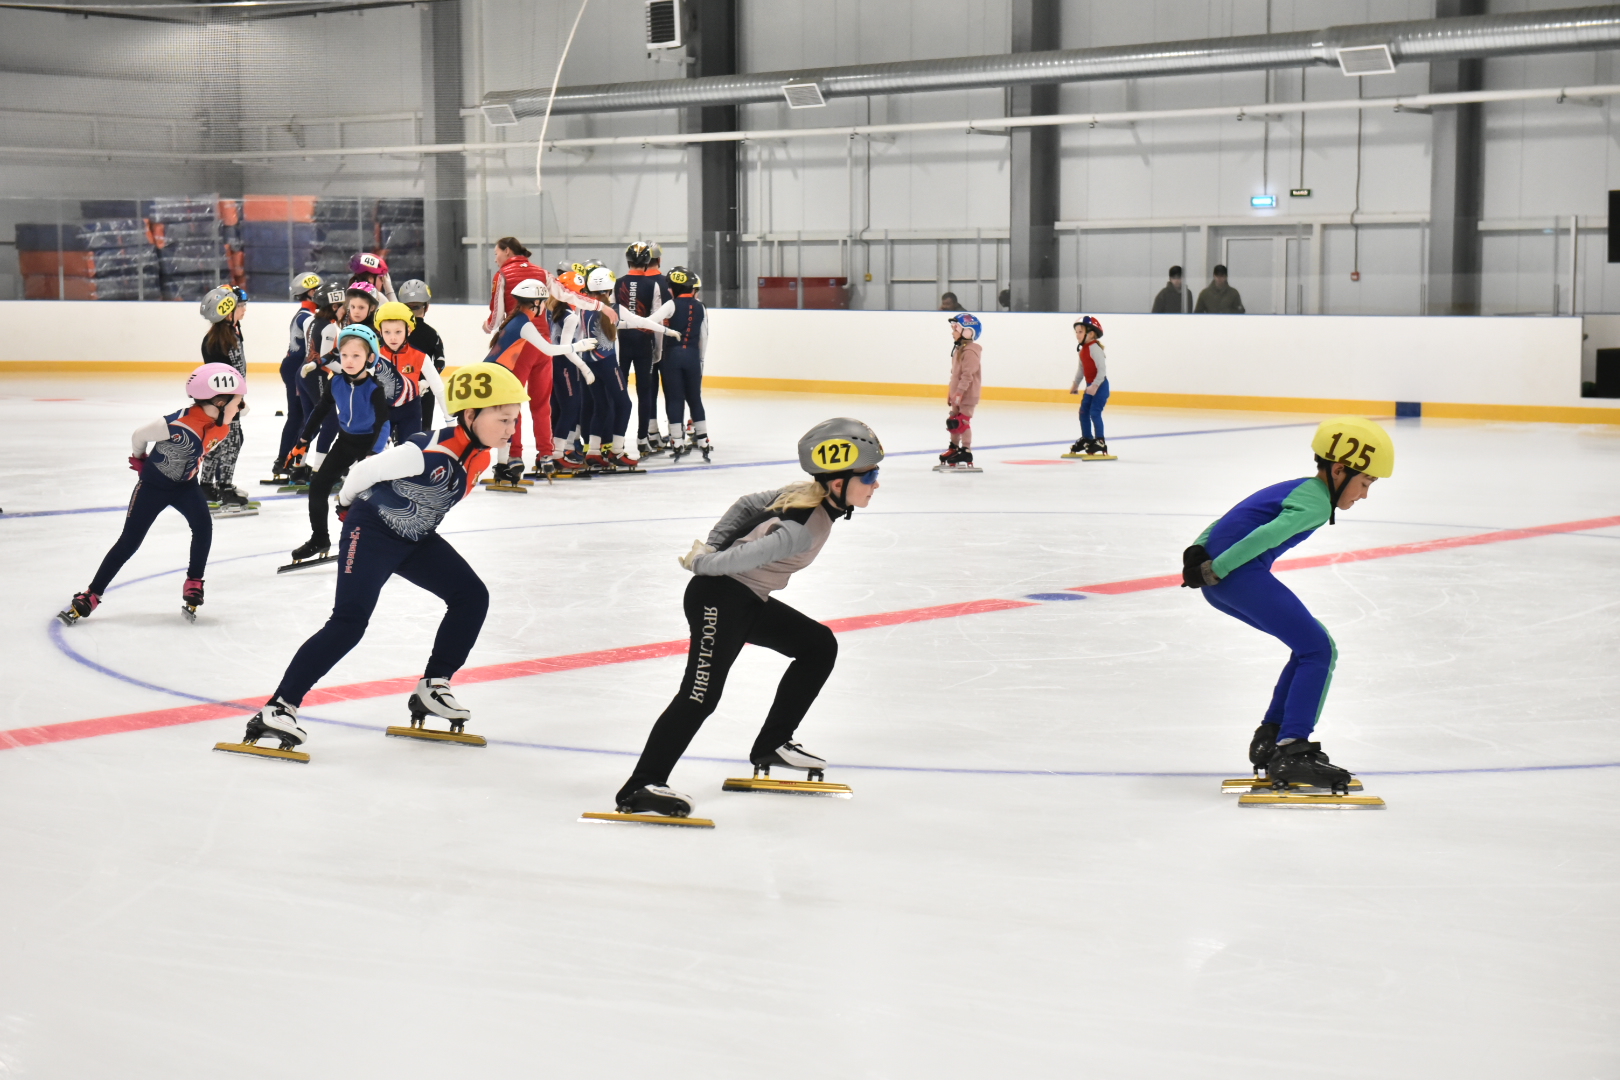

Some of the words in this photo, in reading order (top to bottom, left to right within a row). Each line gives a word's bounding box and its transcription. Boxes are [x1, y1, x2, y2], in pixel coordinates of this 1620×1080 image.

[364, 256, 375, 266] 45
[672, 273, 685, 282] 183
[329, 291, 344, 302] 157
[218, 298, 234, 314] 235
[213, 375, 235, 388] 111
[448, 373, 493, 402] 133
[818, 443, 852, 465] 127
[1325, 432, 1376, 472] 125
[689, 605, 718, 704] ЯРОСЛАВИЯ
